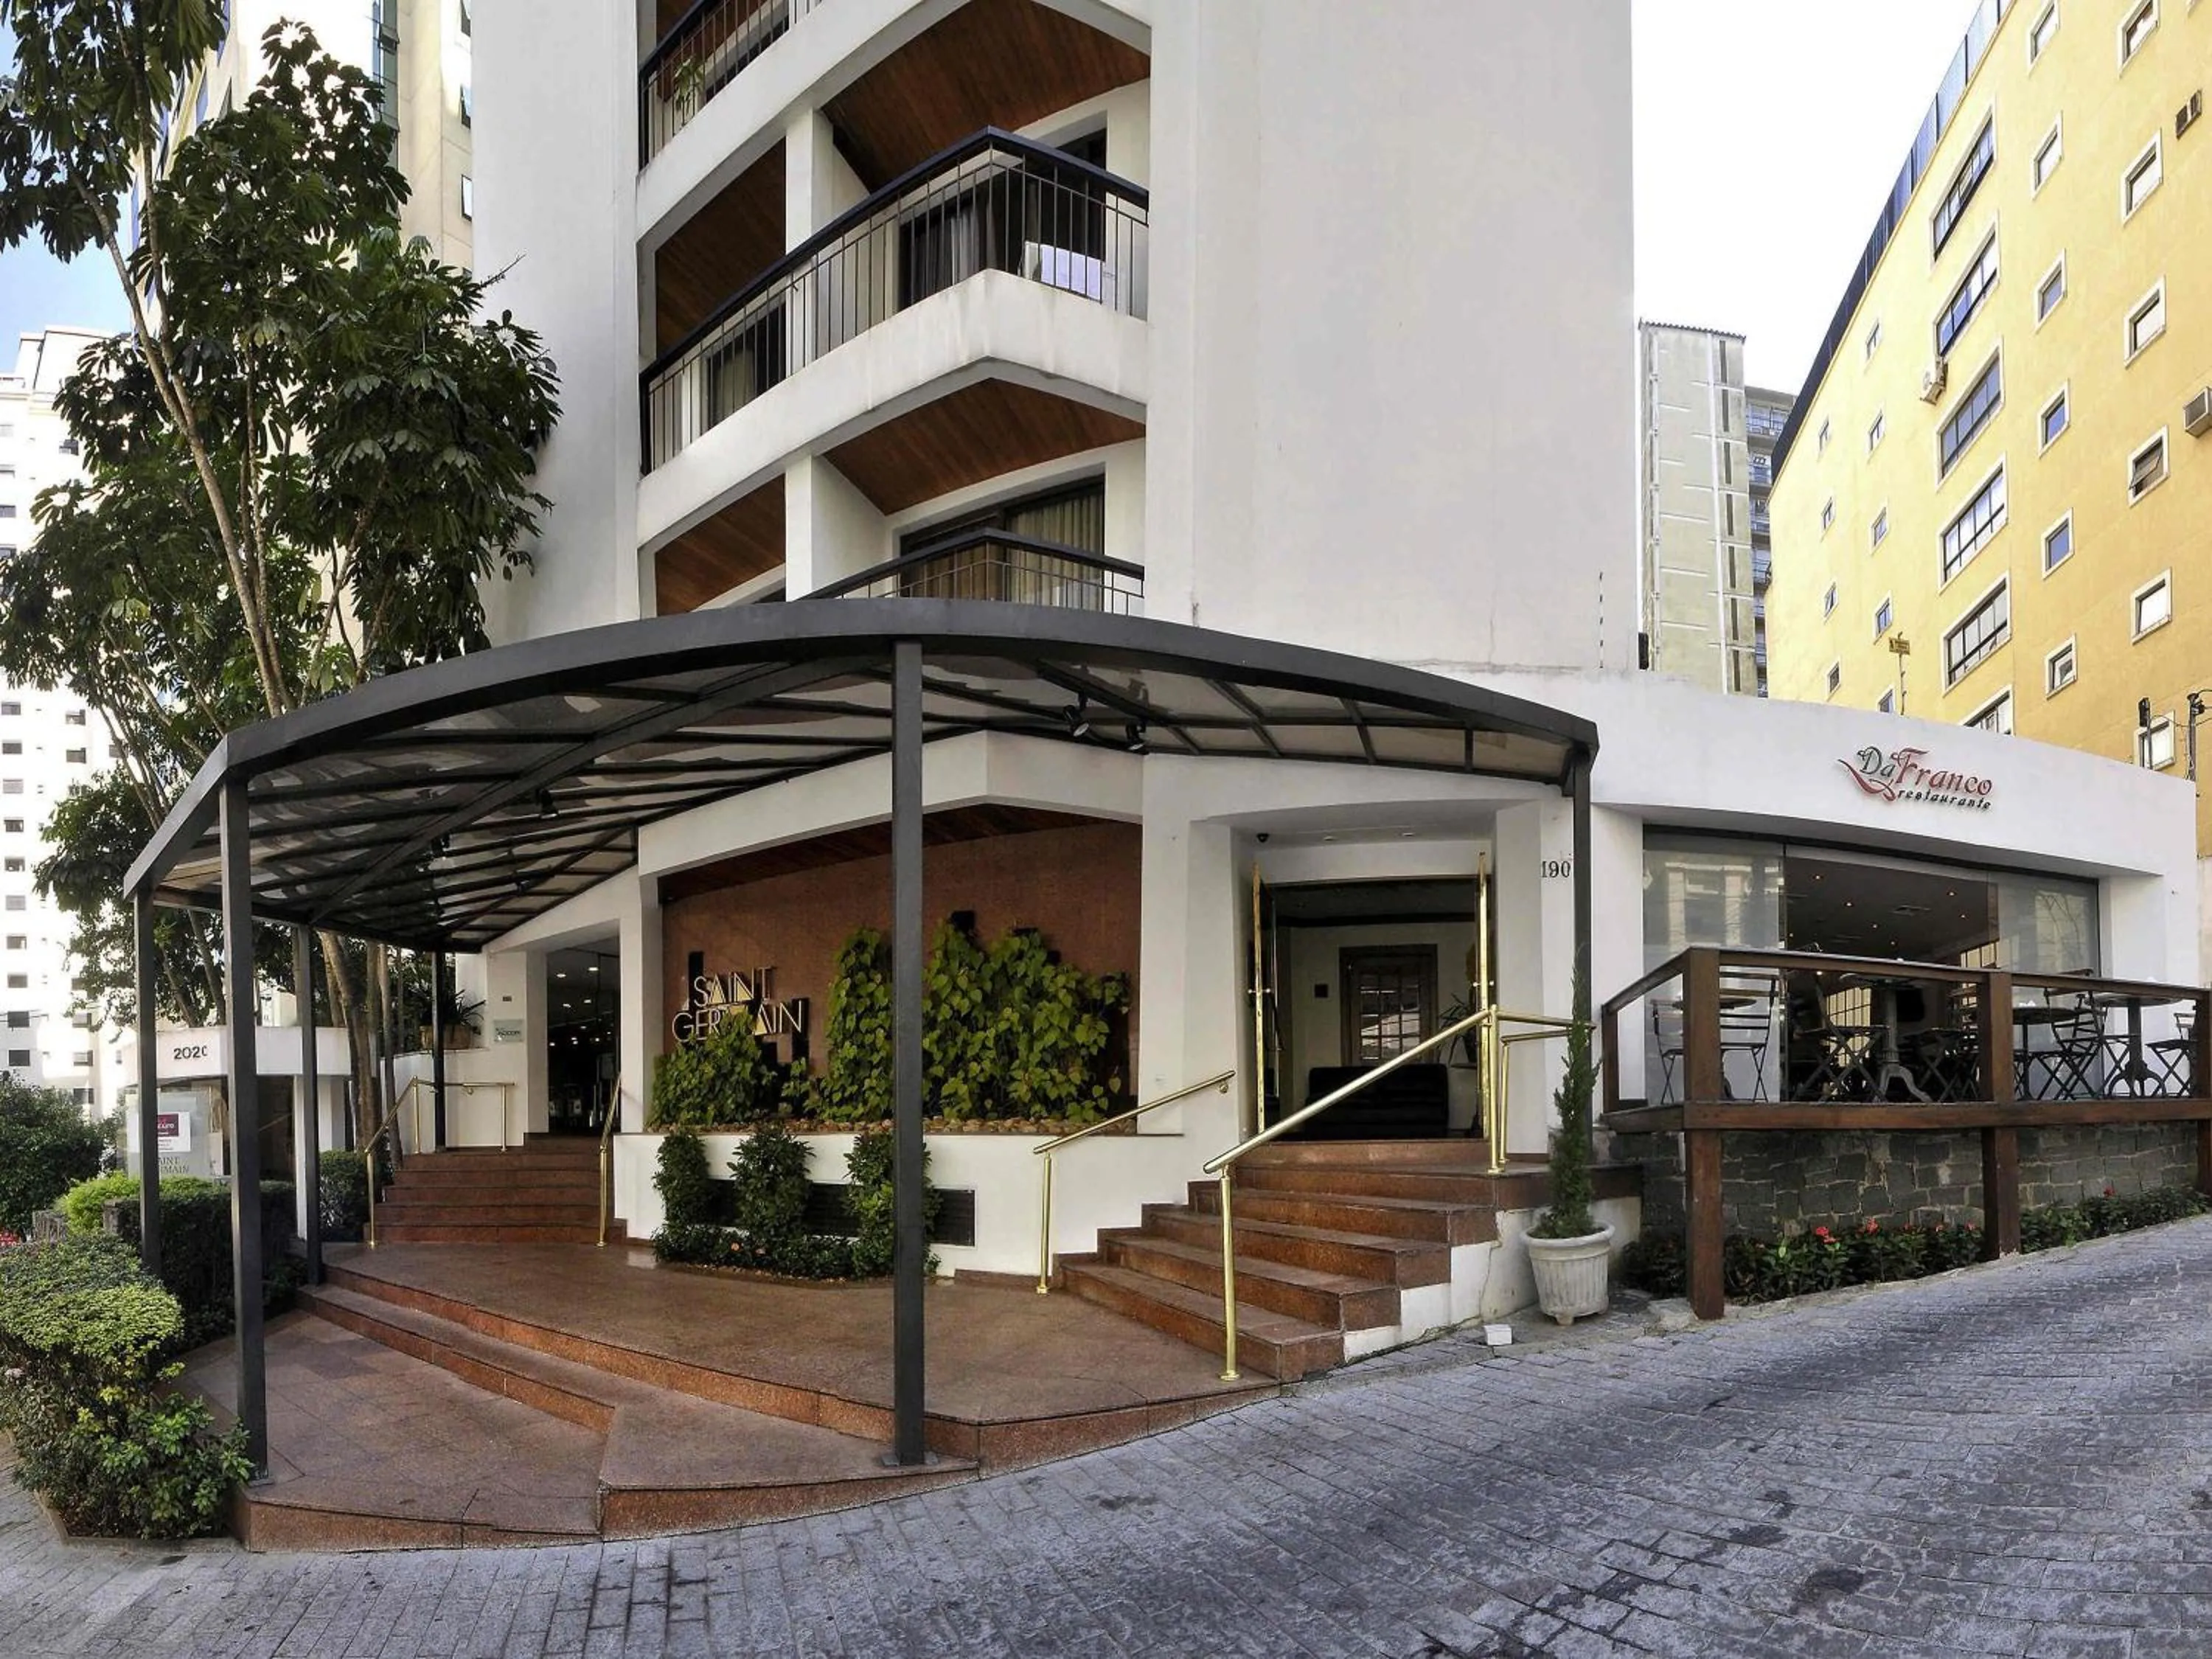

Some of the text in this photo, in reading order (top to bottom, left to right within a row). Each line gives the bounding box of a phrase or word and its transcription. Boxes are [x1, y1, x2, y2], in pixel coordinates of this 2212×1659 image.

[1897, 787, 1992, 810] restaurante
[1541, 860, 1571, 877] 190
[694, 967, 772, 1007] SAINT
[672, 1001, 802, 1043] GERAIN
